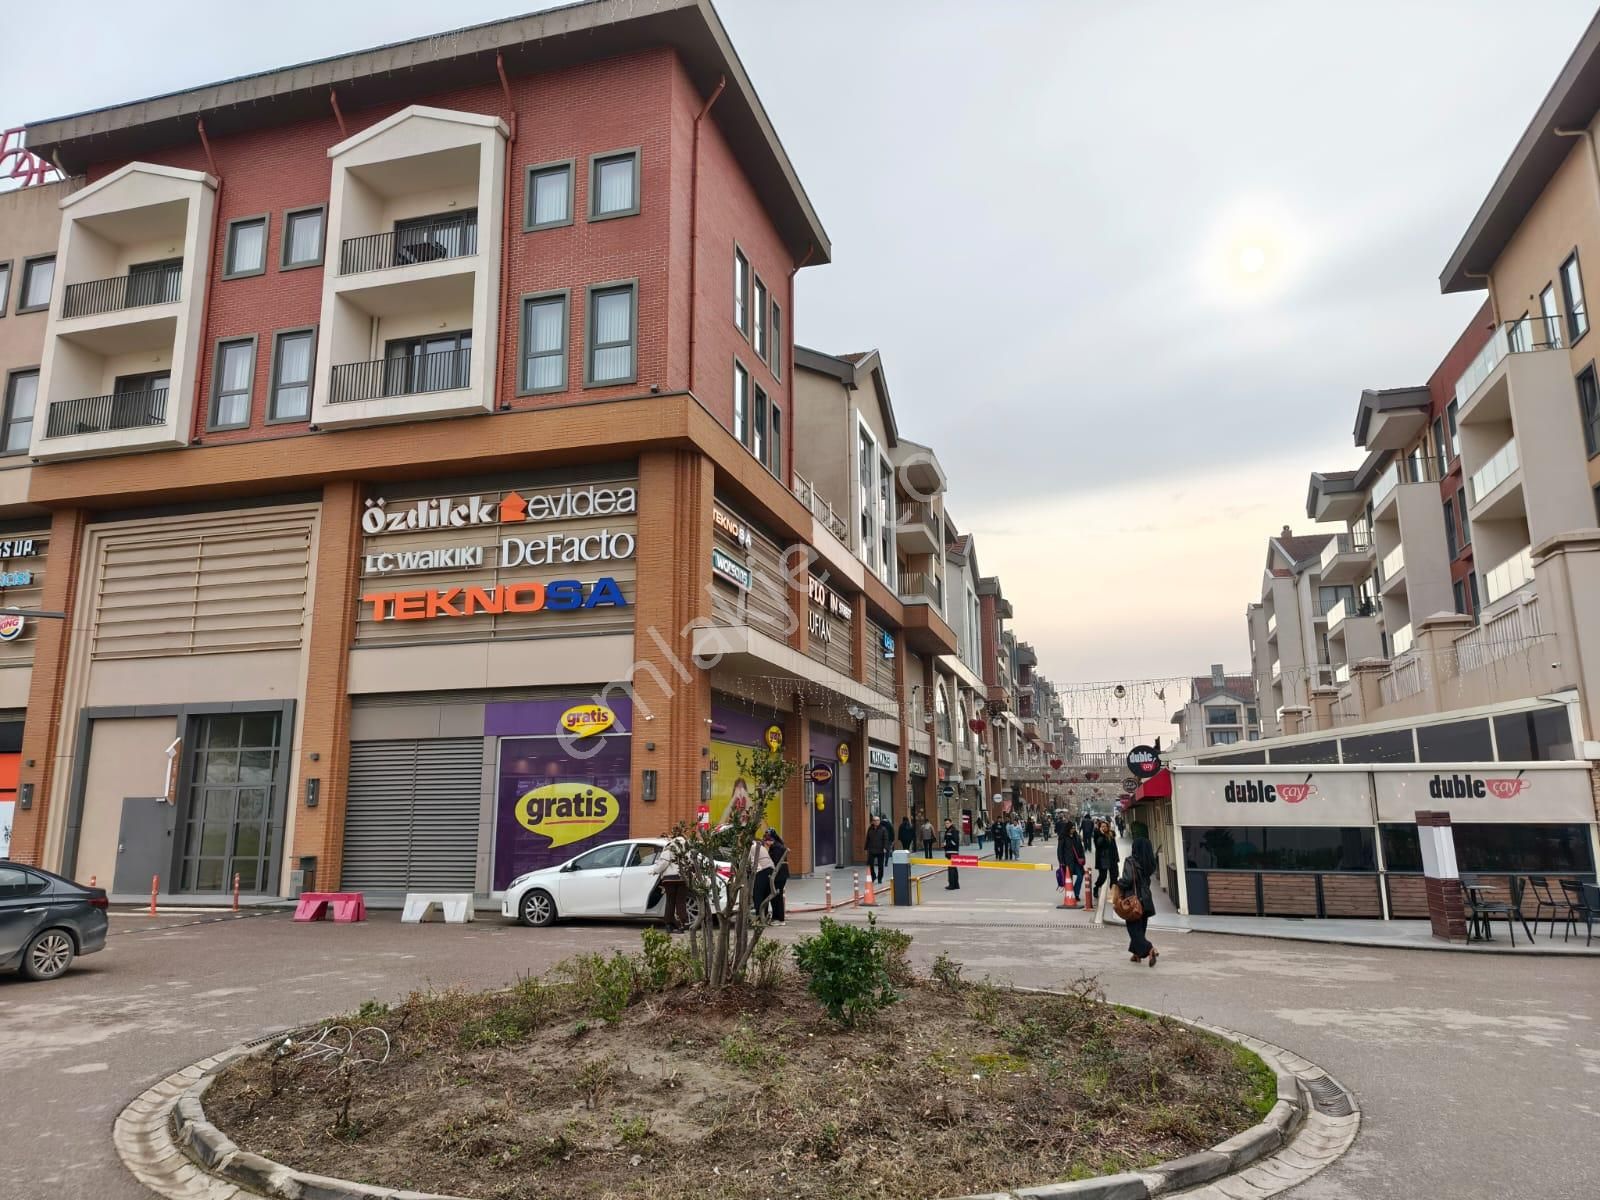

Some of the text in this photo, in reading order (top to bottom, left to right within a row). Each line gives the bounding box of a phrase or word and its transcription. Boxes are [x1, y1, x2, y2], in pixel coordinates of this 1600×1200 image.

[361, 495, 498, 534] Özdilek
[527, 486, 637, 521] evidea
[366, 552, 395, 573] LC
[502, 528, 635, 568] DeFacto
[363, 577, 627, 622] TEKNOSA
[808, 575, 826, 607] FLO
[807, 609, 832, 643] UFIAN
[567, 707, 609, 727] gratis
[1224, 780, 1277, 803] duble
[1429, 774, 1487, 799] duble
[526, 789, 608, 825] gratis
